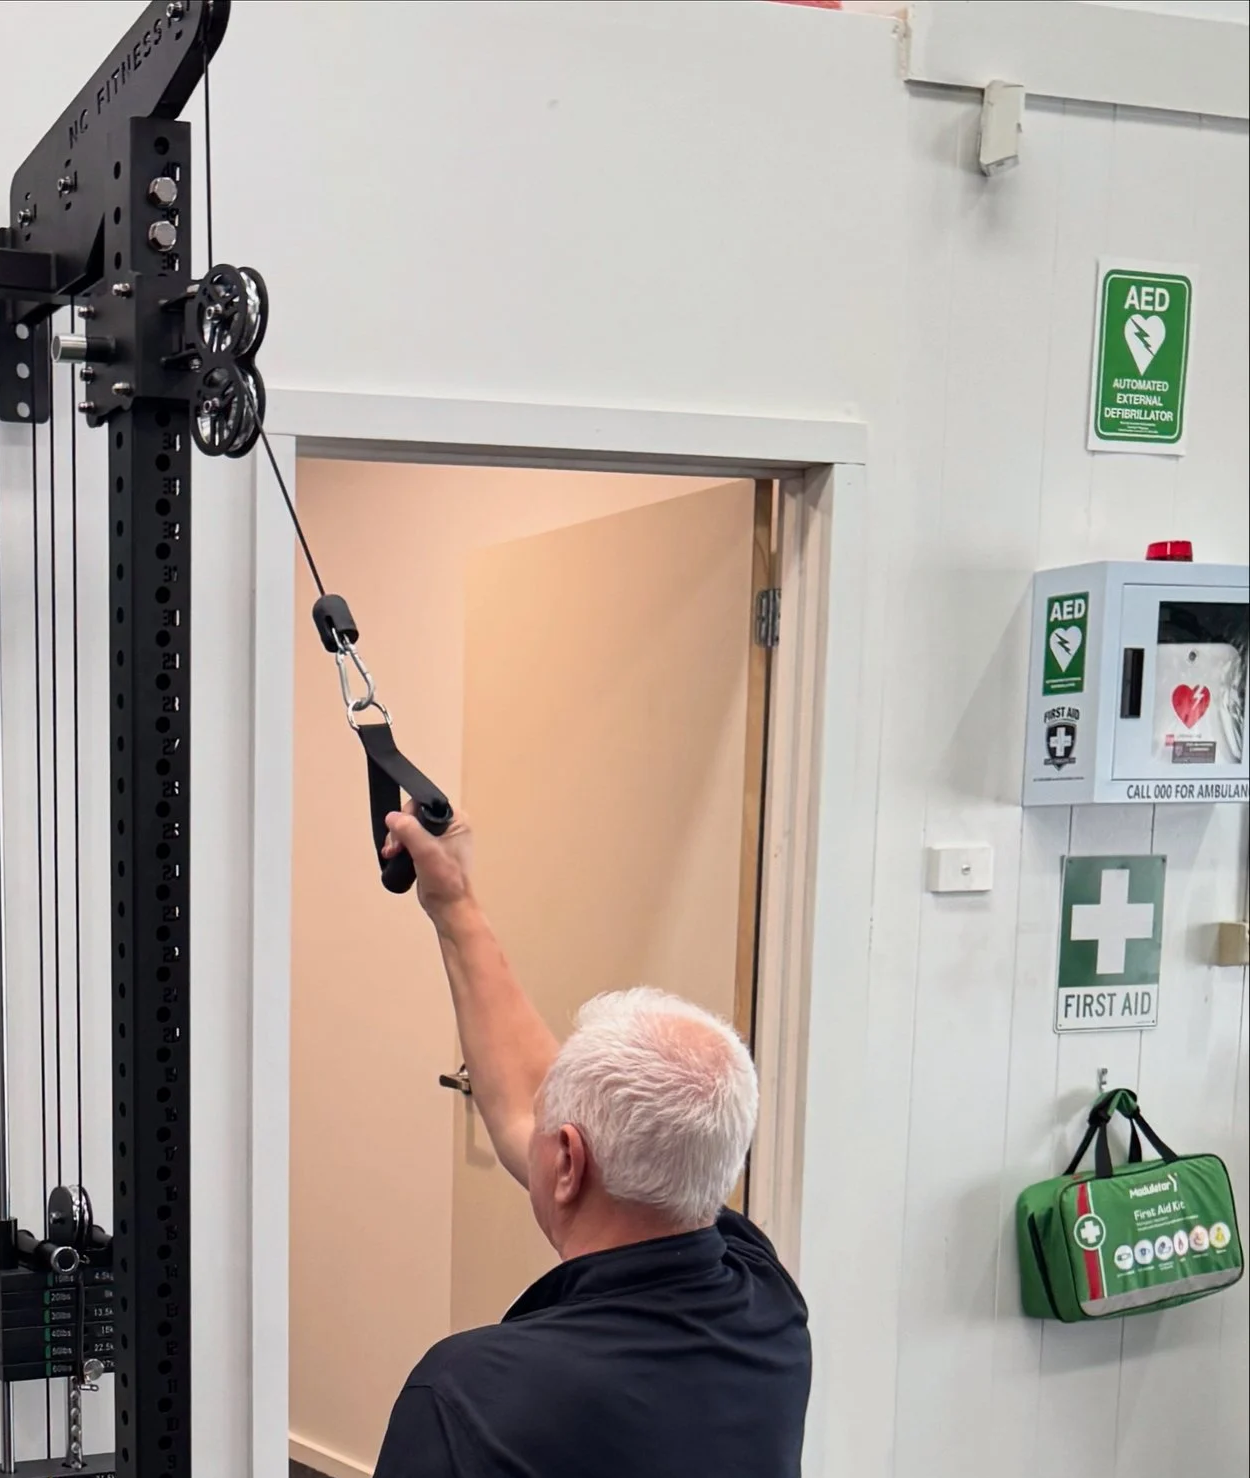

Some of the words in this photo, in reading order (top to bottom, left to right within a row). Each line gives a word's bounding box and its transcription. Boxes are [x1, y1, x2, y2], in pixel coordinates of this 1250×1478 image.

[96, 17, 163, 115] FITNESS
[1124, 285, 1170, 313] AED
[1112, 378, 1169, 391] AUTOMATED
[1116, 394, 1163, 407] EXTERNAL
[1104, 408, 1173, 422] DEFIBRILLATOR
[1049, 598, 1086, 622] AED
[1043, 706, 1065, 724] FIRST
[1066, 705, 1081, 721] AID
[1126, 785, 1151, 799] CALL
[1154, 785, 1173, 799] 000
[1175, 784, 1195, 798] FOR
[1064, 992, 1117, 1018] FIRST
[1121, 991, 1151, 1016] AID
[1134, 1208, 1156, 1221] First
[1157, 1204, 1171, 1215] Aid
[1172, 1200, 1186, 1211] Kit
